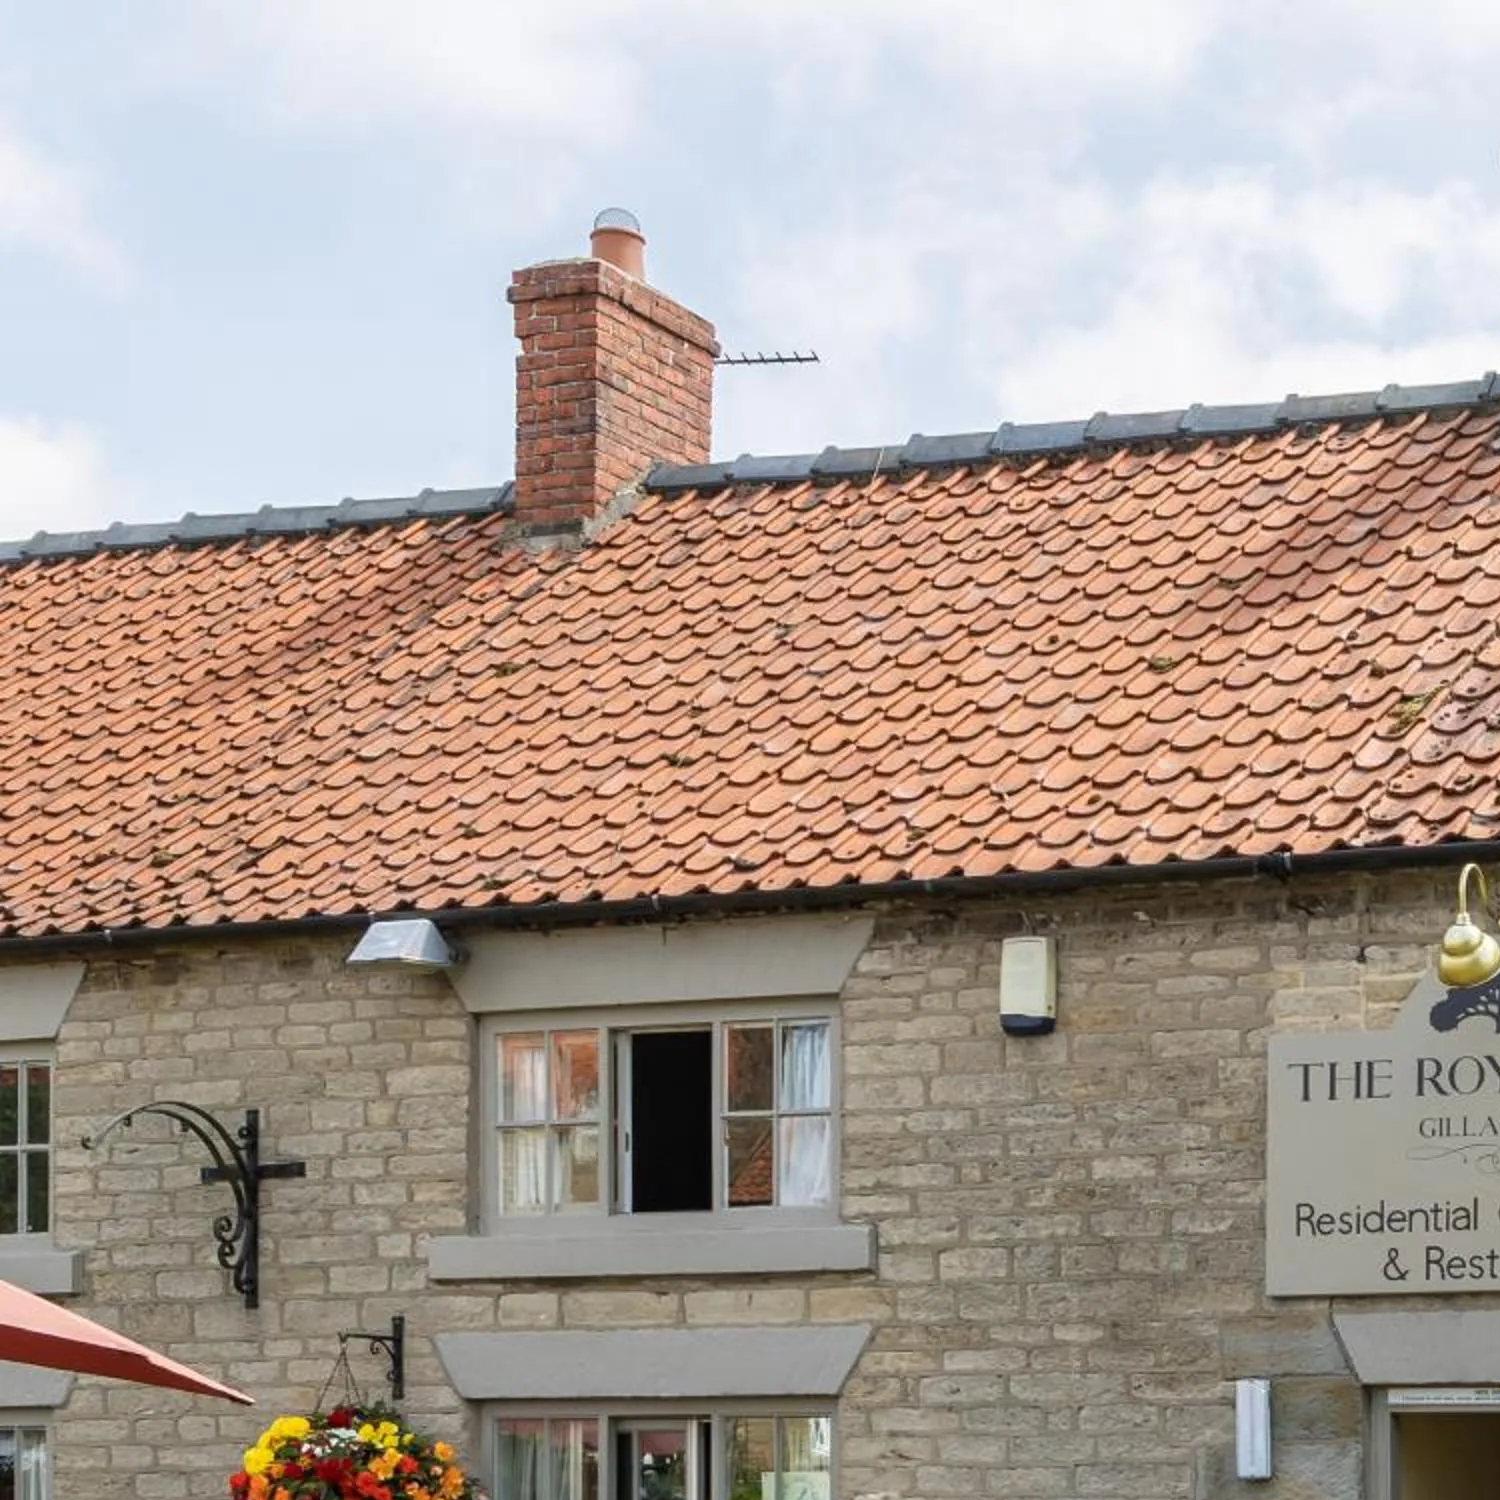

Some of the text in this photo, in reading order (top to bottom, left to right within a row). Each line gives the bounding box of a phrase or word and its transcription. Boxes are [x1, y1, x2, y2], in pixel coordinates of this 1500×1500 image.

[1287, 1059, 1393, 1101] THE
[1295, 1198, 1479, 1237] Residential
[1383, 1248, 1409, 1281] &
